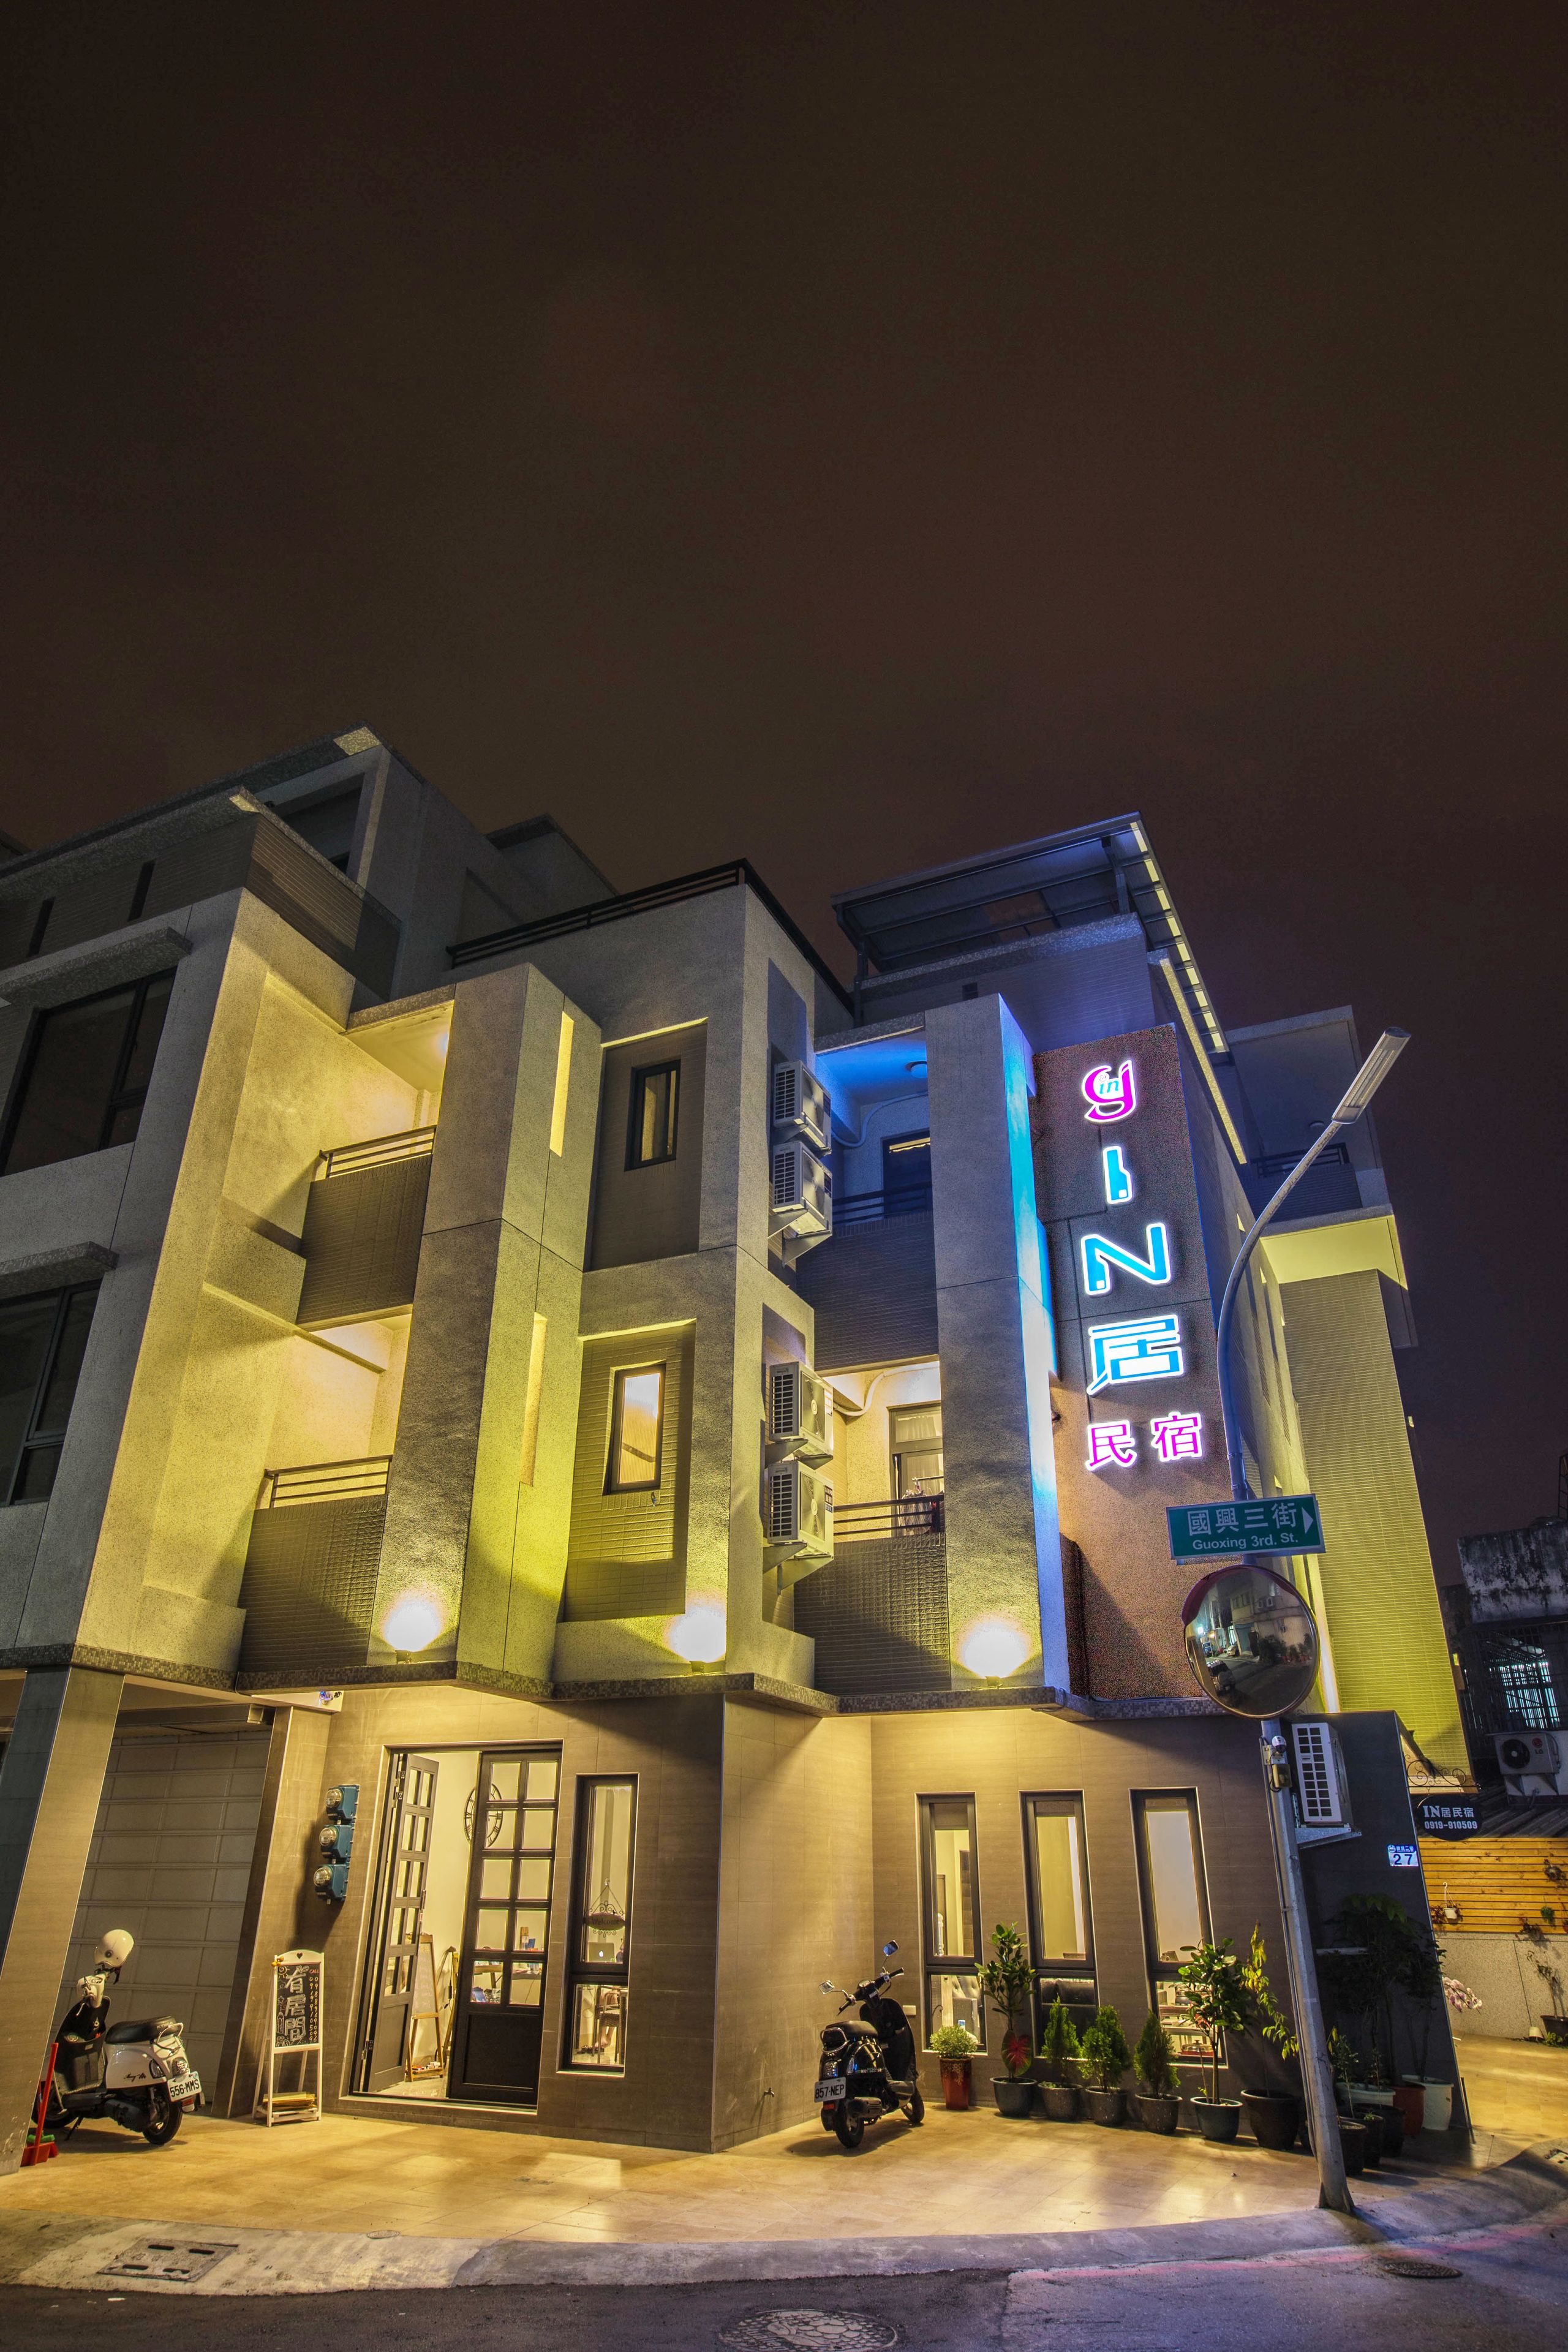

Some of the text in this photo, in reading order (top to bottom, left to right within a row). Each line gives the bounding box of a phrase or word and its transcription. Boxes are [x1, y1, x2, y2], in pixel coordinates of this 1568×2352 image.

[1085, 1411, 1203, 1471] 民宿
[1187, 1502, 1297, 1536] 國興三街
[1193, 1532, 1298, 1550] Guoxing 3rd. St.
[1393, 1854, 1412, 1865] 27
[170, 2079, 200, 2097] 556-MMS
[815, 2084, 845, 2098] 857-NEP
